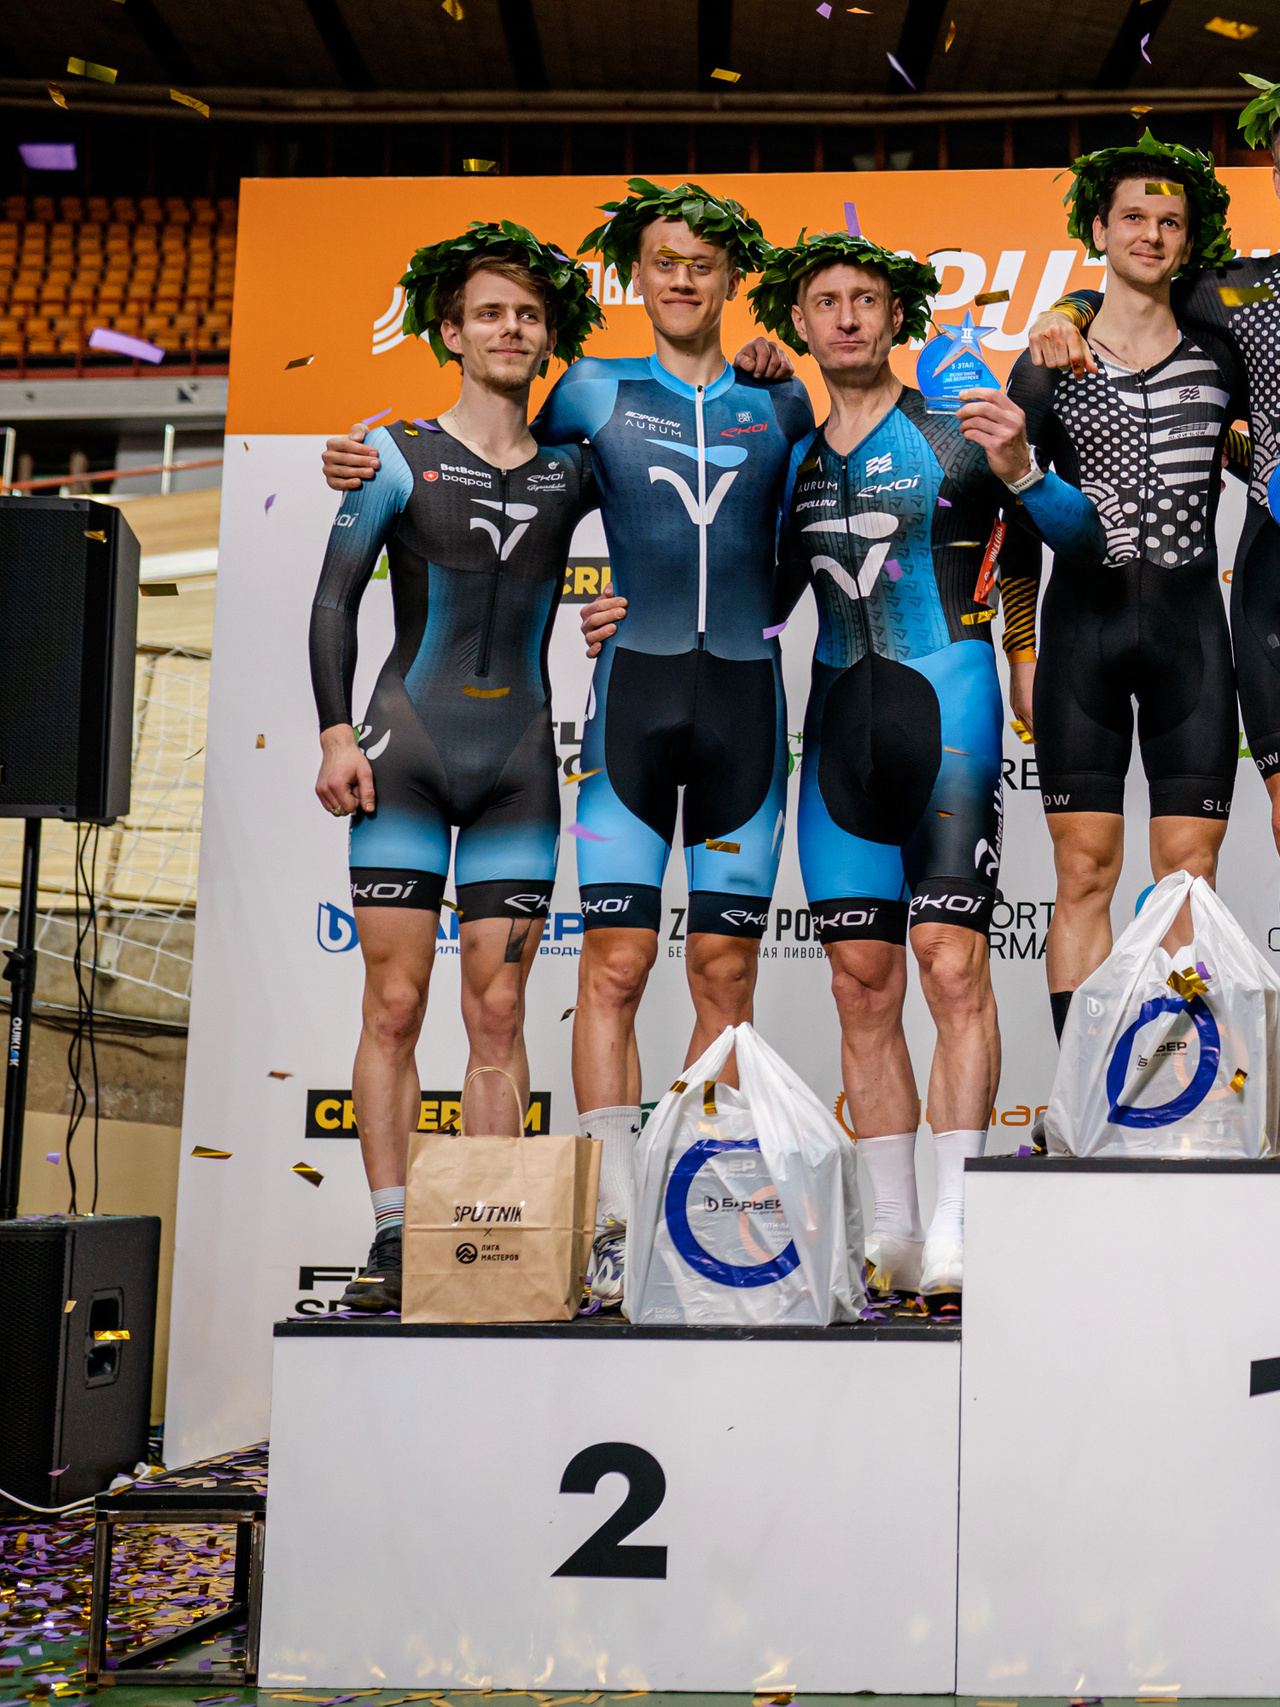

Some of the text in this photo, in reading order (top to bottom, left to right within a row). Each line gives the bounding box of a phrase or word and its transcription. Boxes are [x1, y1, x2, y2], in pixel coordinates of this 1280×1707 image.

[625, 419, 682, 438] AURUM
[440, 463, 492, 480] BetBoom
[1256, 752, 1279, 771] OW
[1043, 794, 1071, 806] OW
[454, 1205, 523, 1222] SPUTNIK
[481, 1244, 500, 1252] ЛИГА
[550, 1442, 668, 1580] 2
